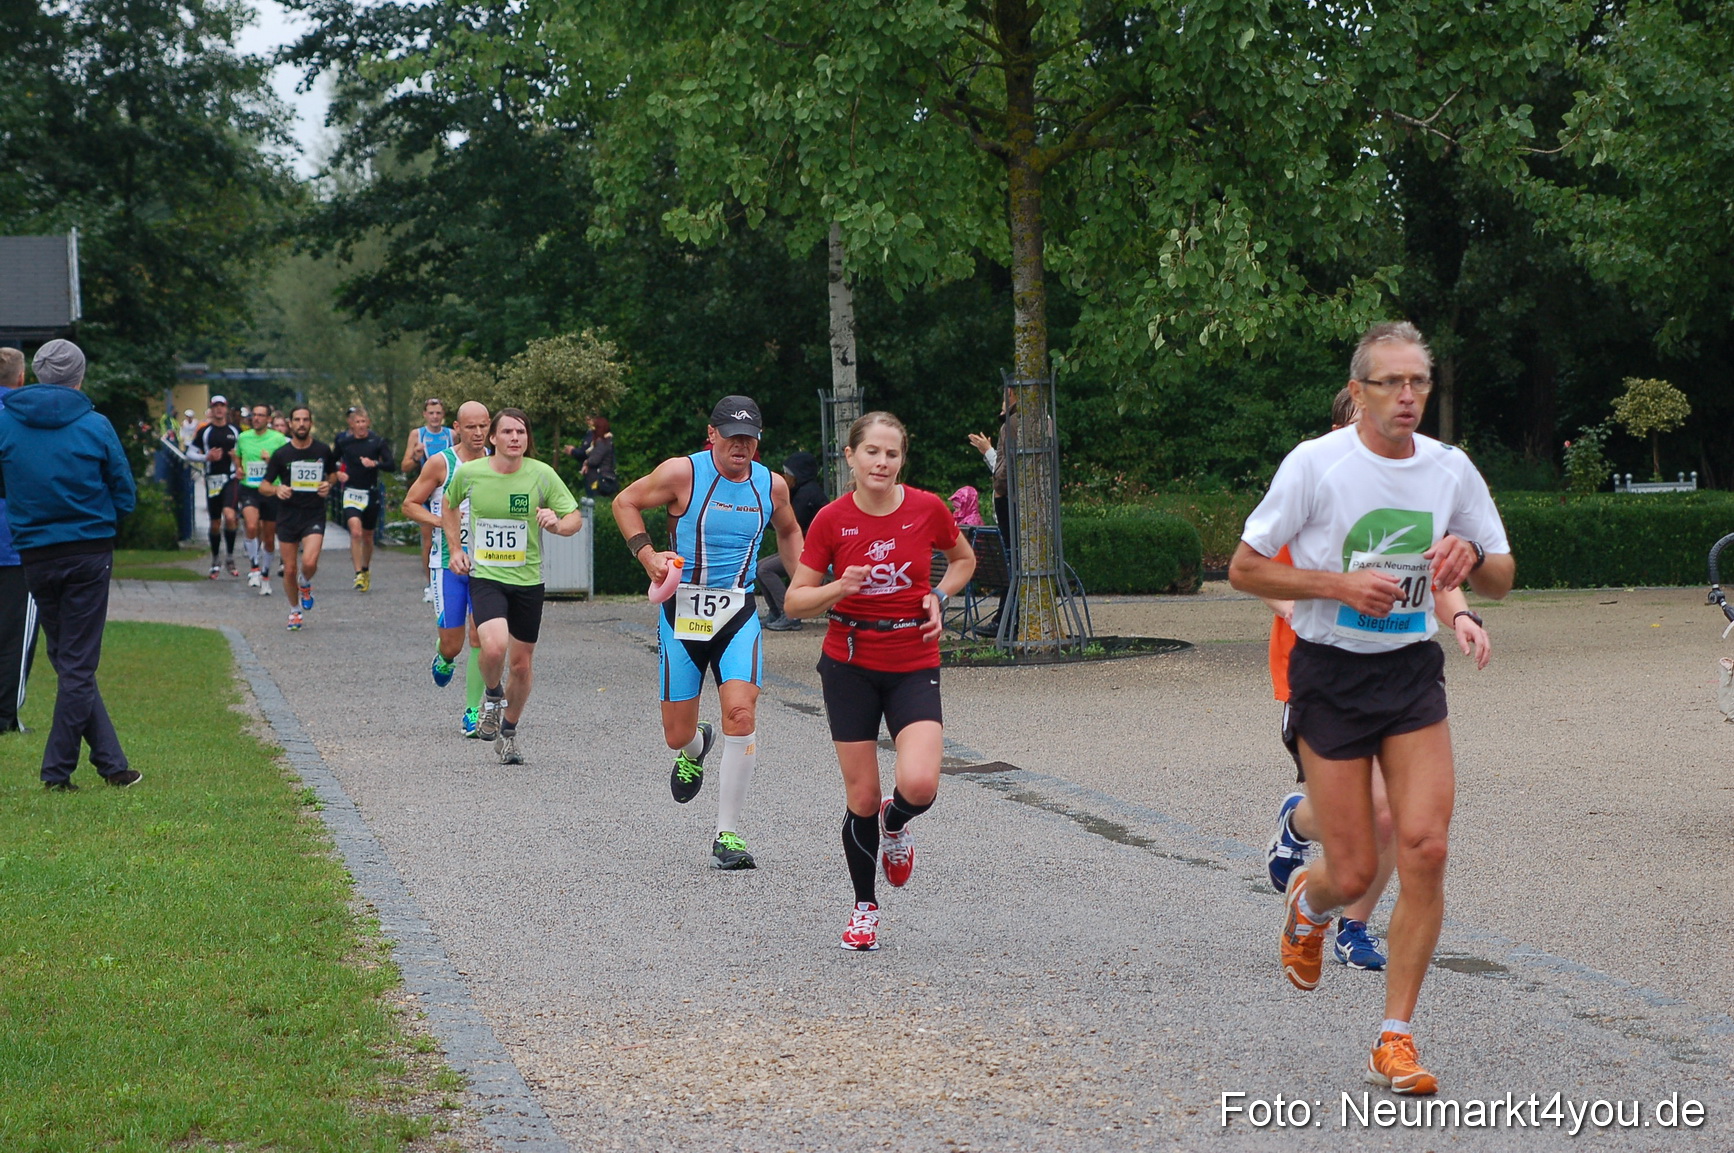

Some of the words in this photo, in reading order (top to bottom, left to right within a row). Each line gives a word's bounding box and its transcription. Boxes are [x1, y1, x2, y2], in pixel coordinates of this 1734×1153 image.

[297, 470, 317, 480] 325
[841, 526, 859, 537] Irmi
[485, 530, 517, 549] 515
[484, 551, 516, 560] Johannes
[1384, 561, 1427, 572] Neumarkt
[1398, 575, 1427, 609] 40
[892, 621, 917, 630] GARMIN
[1357, 613, 1411, 632] Siegfried
